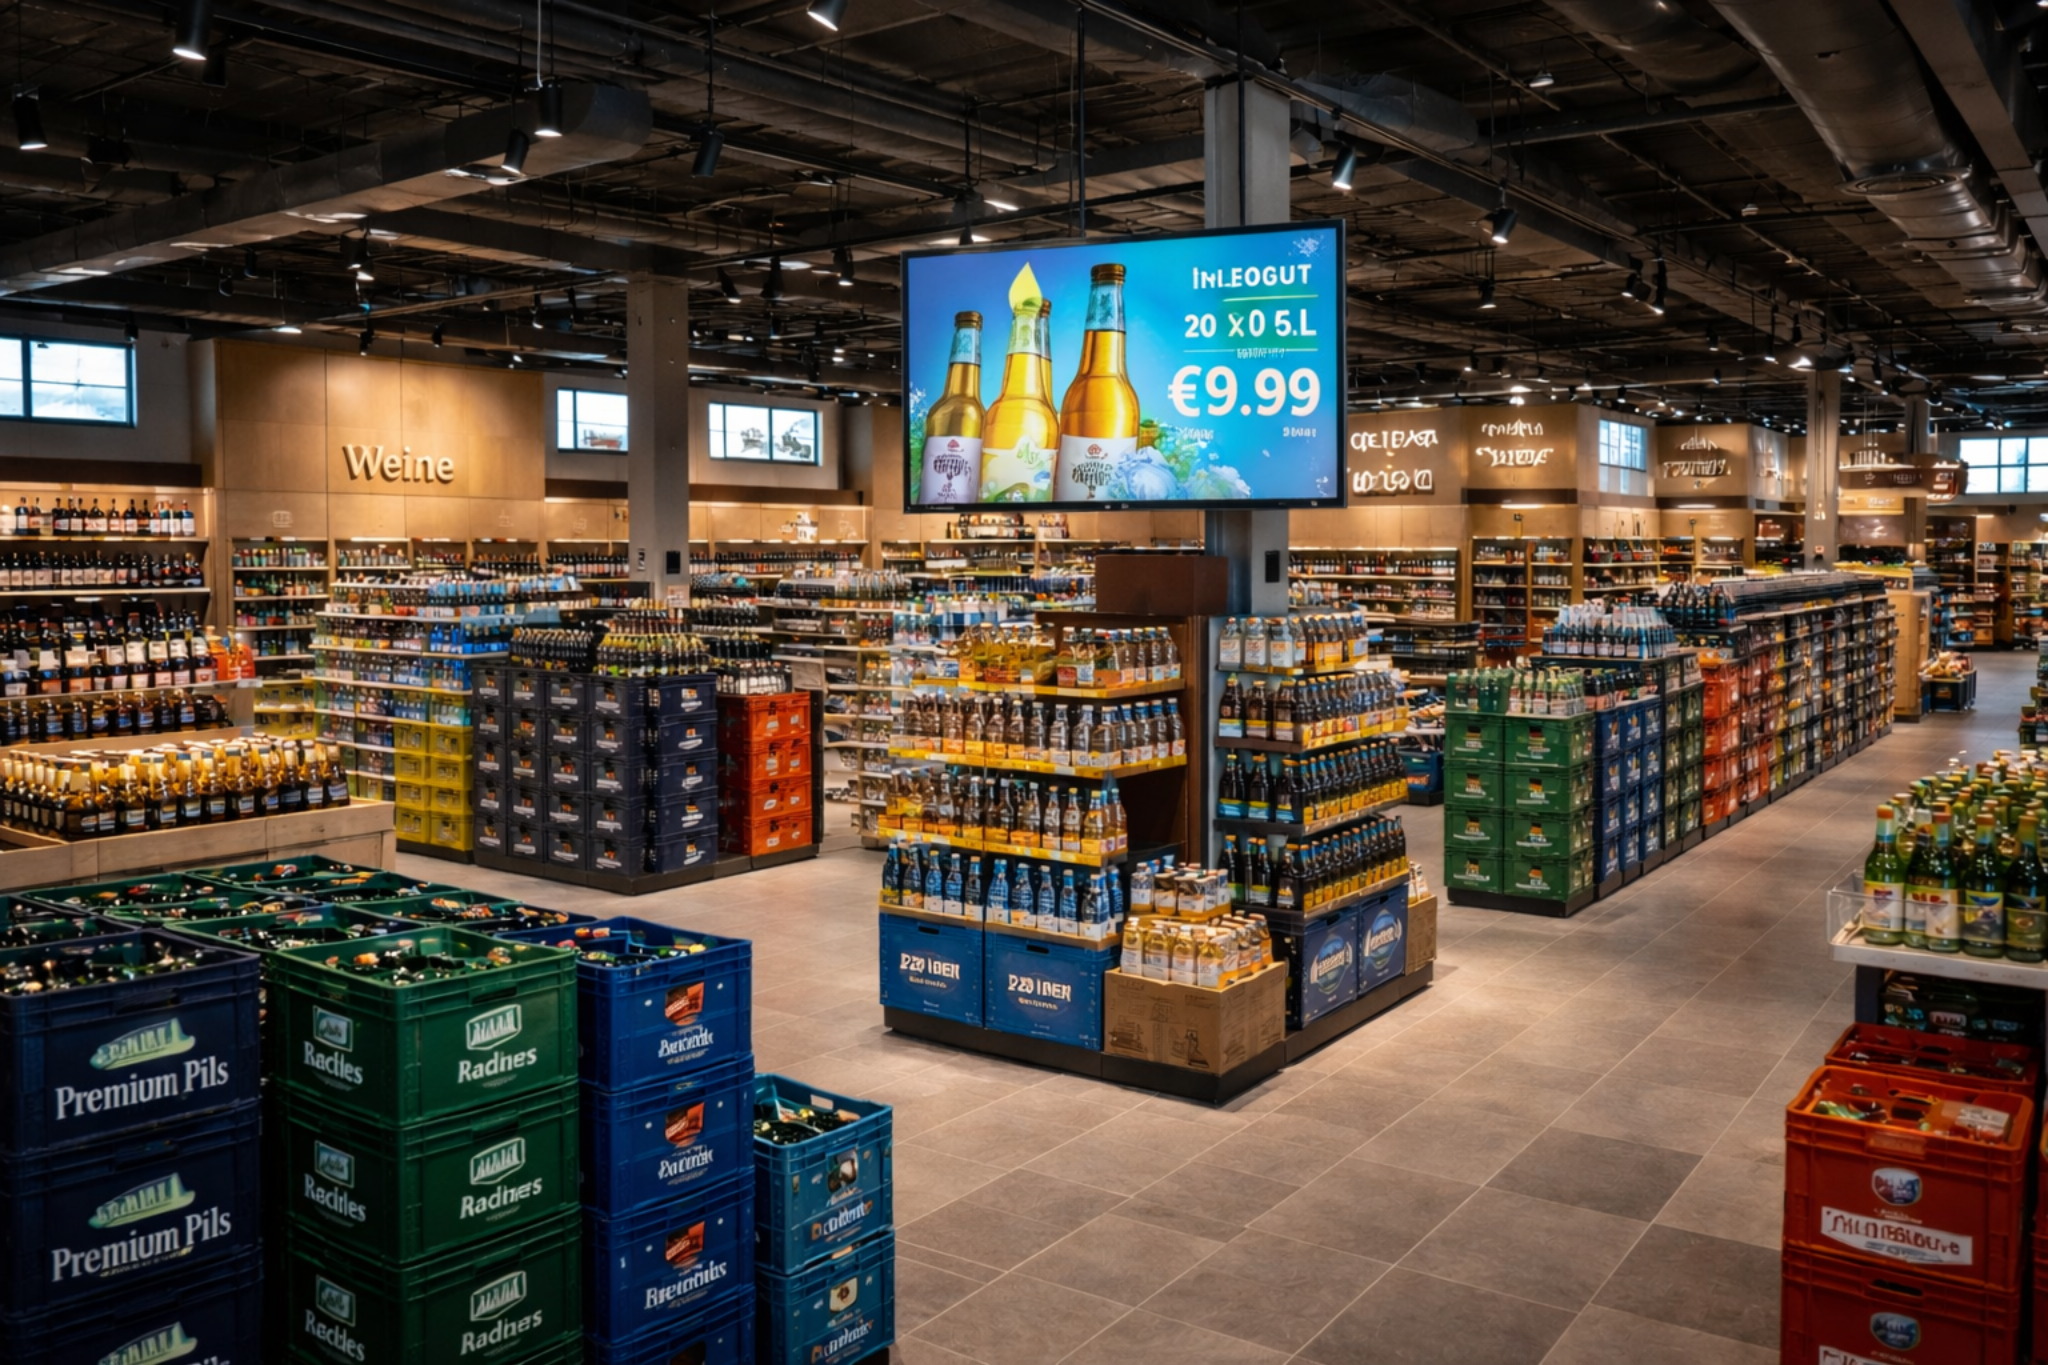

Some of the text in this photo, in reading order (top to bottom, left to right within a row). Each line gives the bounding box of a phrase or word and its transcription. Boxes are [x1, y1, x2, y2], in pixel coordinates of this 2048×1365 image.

[1184, 313, 1217, 338] 20
[1167, 364, 1321, 418] €9.99
[343, 443, 455, 483] Weine
[55, 1055, 229, 1121] Premium Pils
[52, 1229, 181, 1283] Premium
[184, 1206, 232, 1247] Pils
